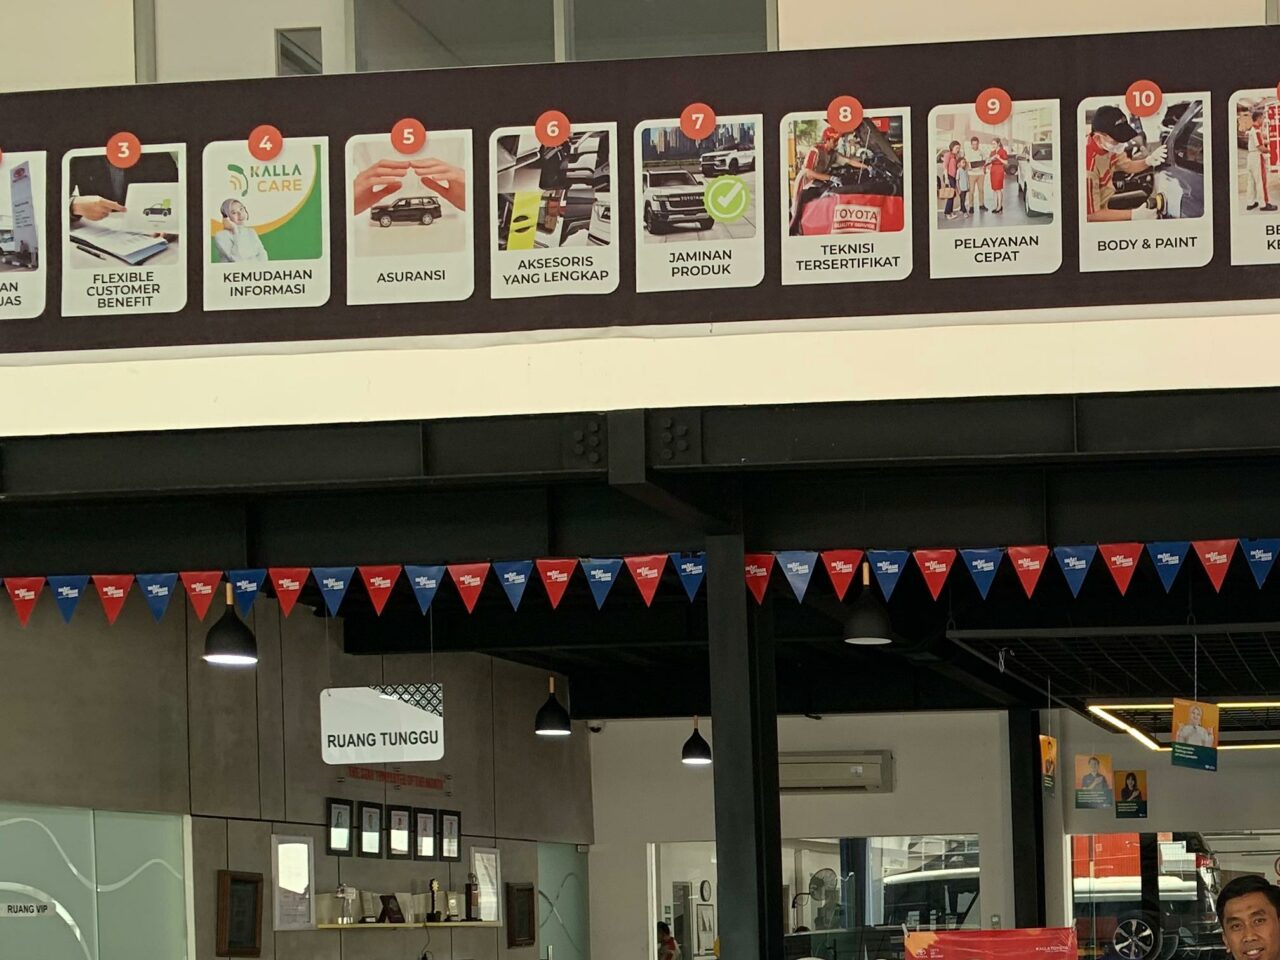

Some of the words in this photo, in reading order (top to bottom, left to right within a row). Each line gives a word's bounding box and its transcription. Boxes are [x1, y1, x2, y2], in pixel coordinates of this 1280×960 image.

[1132, 90, 1155, 107] 10
[838, 106, 852, 122] 8
[987, 99, 1000, 115] 9
[546, 121, 559, 137] 6
[691, 114, 704, 129] 7
[259, 135, 273, 150] 4
[402, 129, 415, 144] 5
[117, 143, 130, 158] 3
[250, 164, 302, 178] KALLA
[257, 178, 303, 192] CARE
[835, 207, 879, 221] TOYOTA
[820, 242, 875, 256] TEKNISI
[954, 235, 1039, 250] PELAYANAN
[1097, 238, 1139, 252] BODY
[1142, 238, 1153, 250] &
[1155, 236, 1198, 250] PAINT
[517, 255, 594, 270] AKSESORIS
[668, 249, 733, 264] JAMINAN
[796, 255, 901, 271] TERSERTIFIKAT
[974, 249, 1019, 263] CEPAT
[222, 268, 313, 283] KEMUDAHAN
[376, 269, 446, 284] ASURANSI
[503, 272, 540, 285] YANG
[543, 269, 609, 284] LENGKAP
[671, 262, 731, 277] PRODUK
[93, 271, 154, 285] FLEXIBLE
[86, 283, 161, 297] CUSTOMER
[229, 283, 306, 297] INFORMASI
[97, 295, 153, 308] BENEFIT
[327, 731, 376, 749] RUANG
[379, 729, 439, 747] TUNGGU
[7, 904, 35, 913] RUANG
[36, 904, 48, 913] VIP
